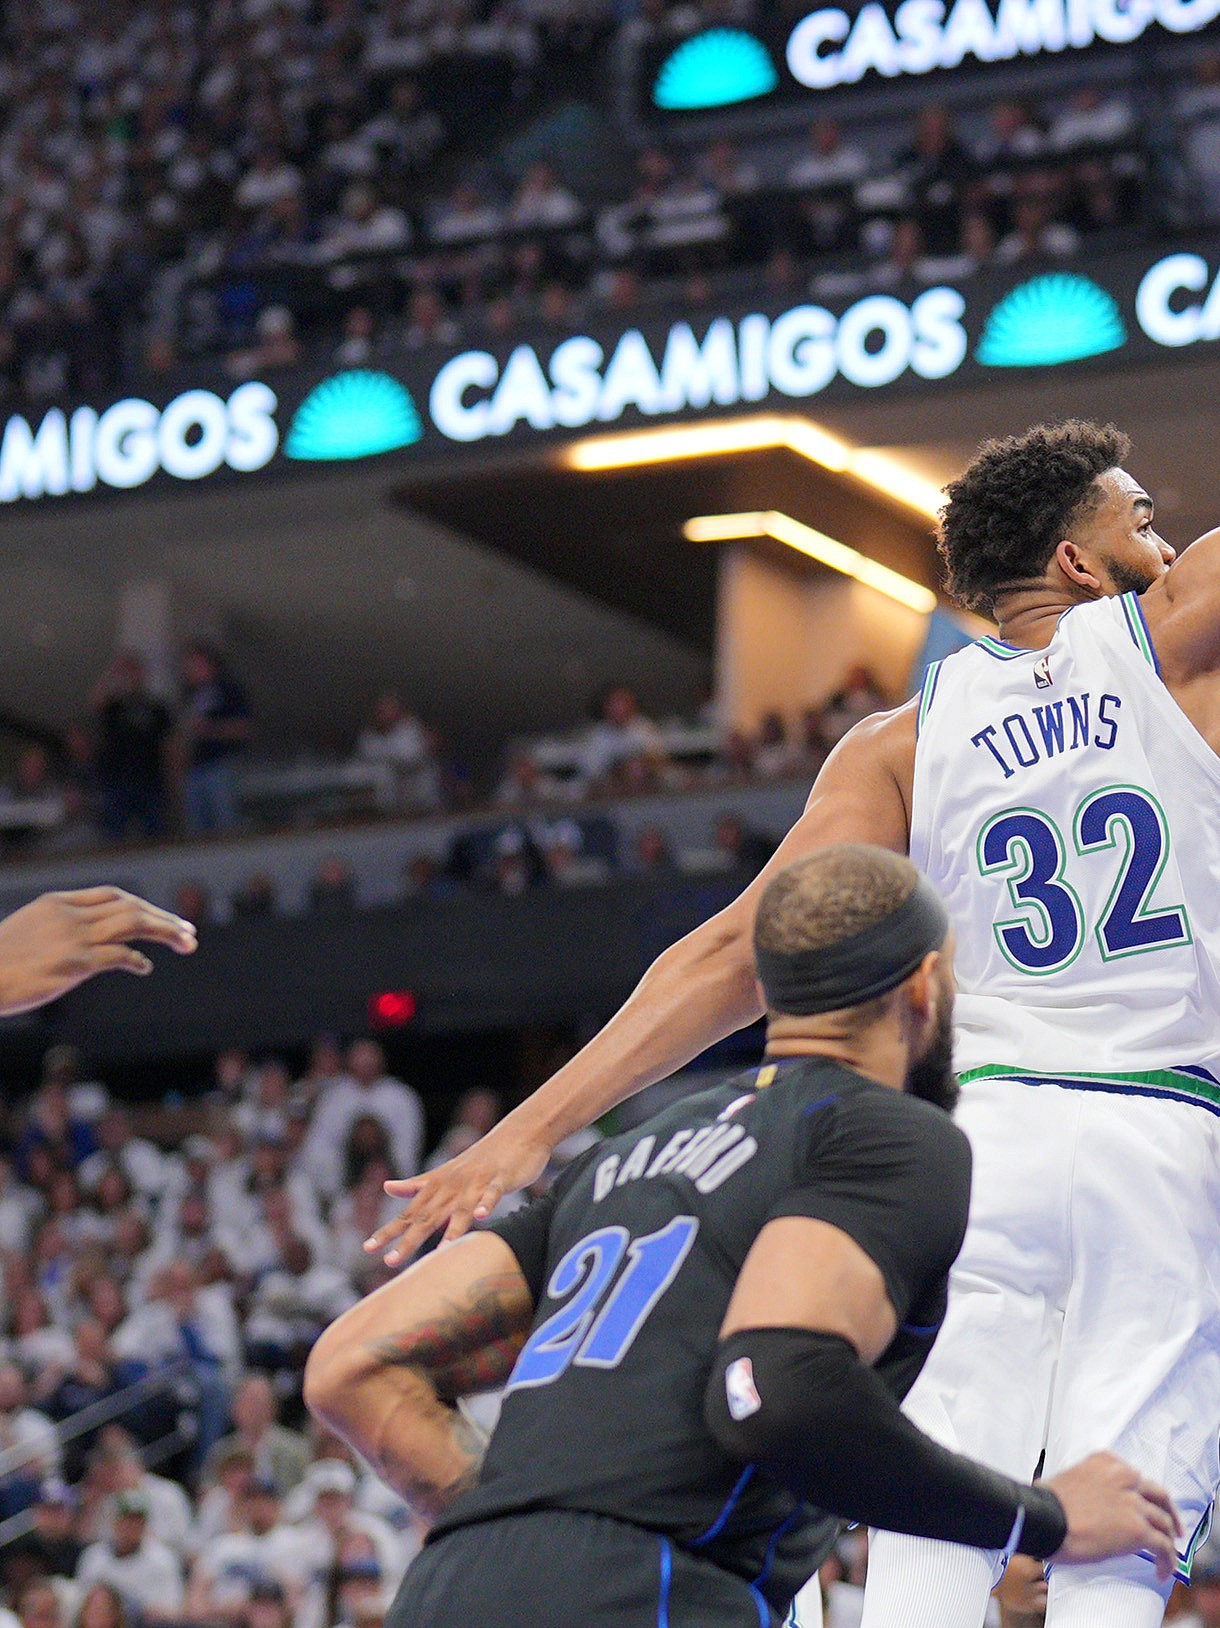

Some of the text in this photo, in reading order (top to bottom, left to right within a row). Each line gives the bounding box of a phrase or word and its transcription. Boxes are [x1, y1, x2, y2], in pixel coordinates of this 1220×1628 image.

[0, 381, 279, 503] MIGOS
[429, 286, 967, 443] CASAMIGOS
[971, 692, 1122, 779] TOWNS
[976, 784, 1194, 976] 32
[504, 1215, 700, 1393] 21
